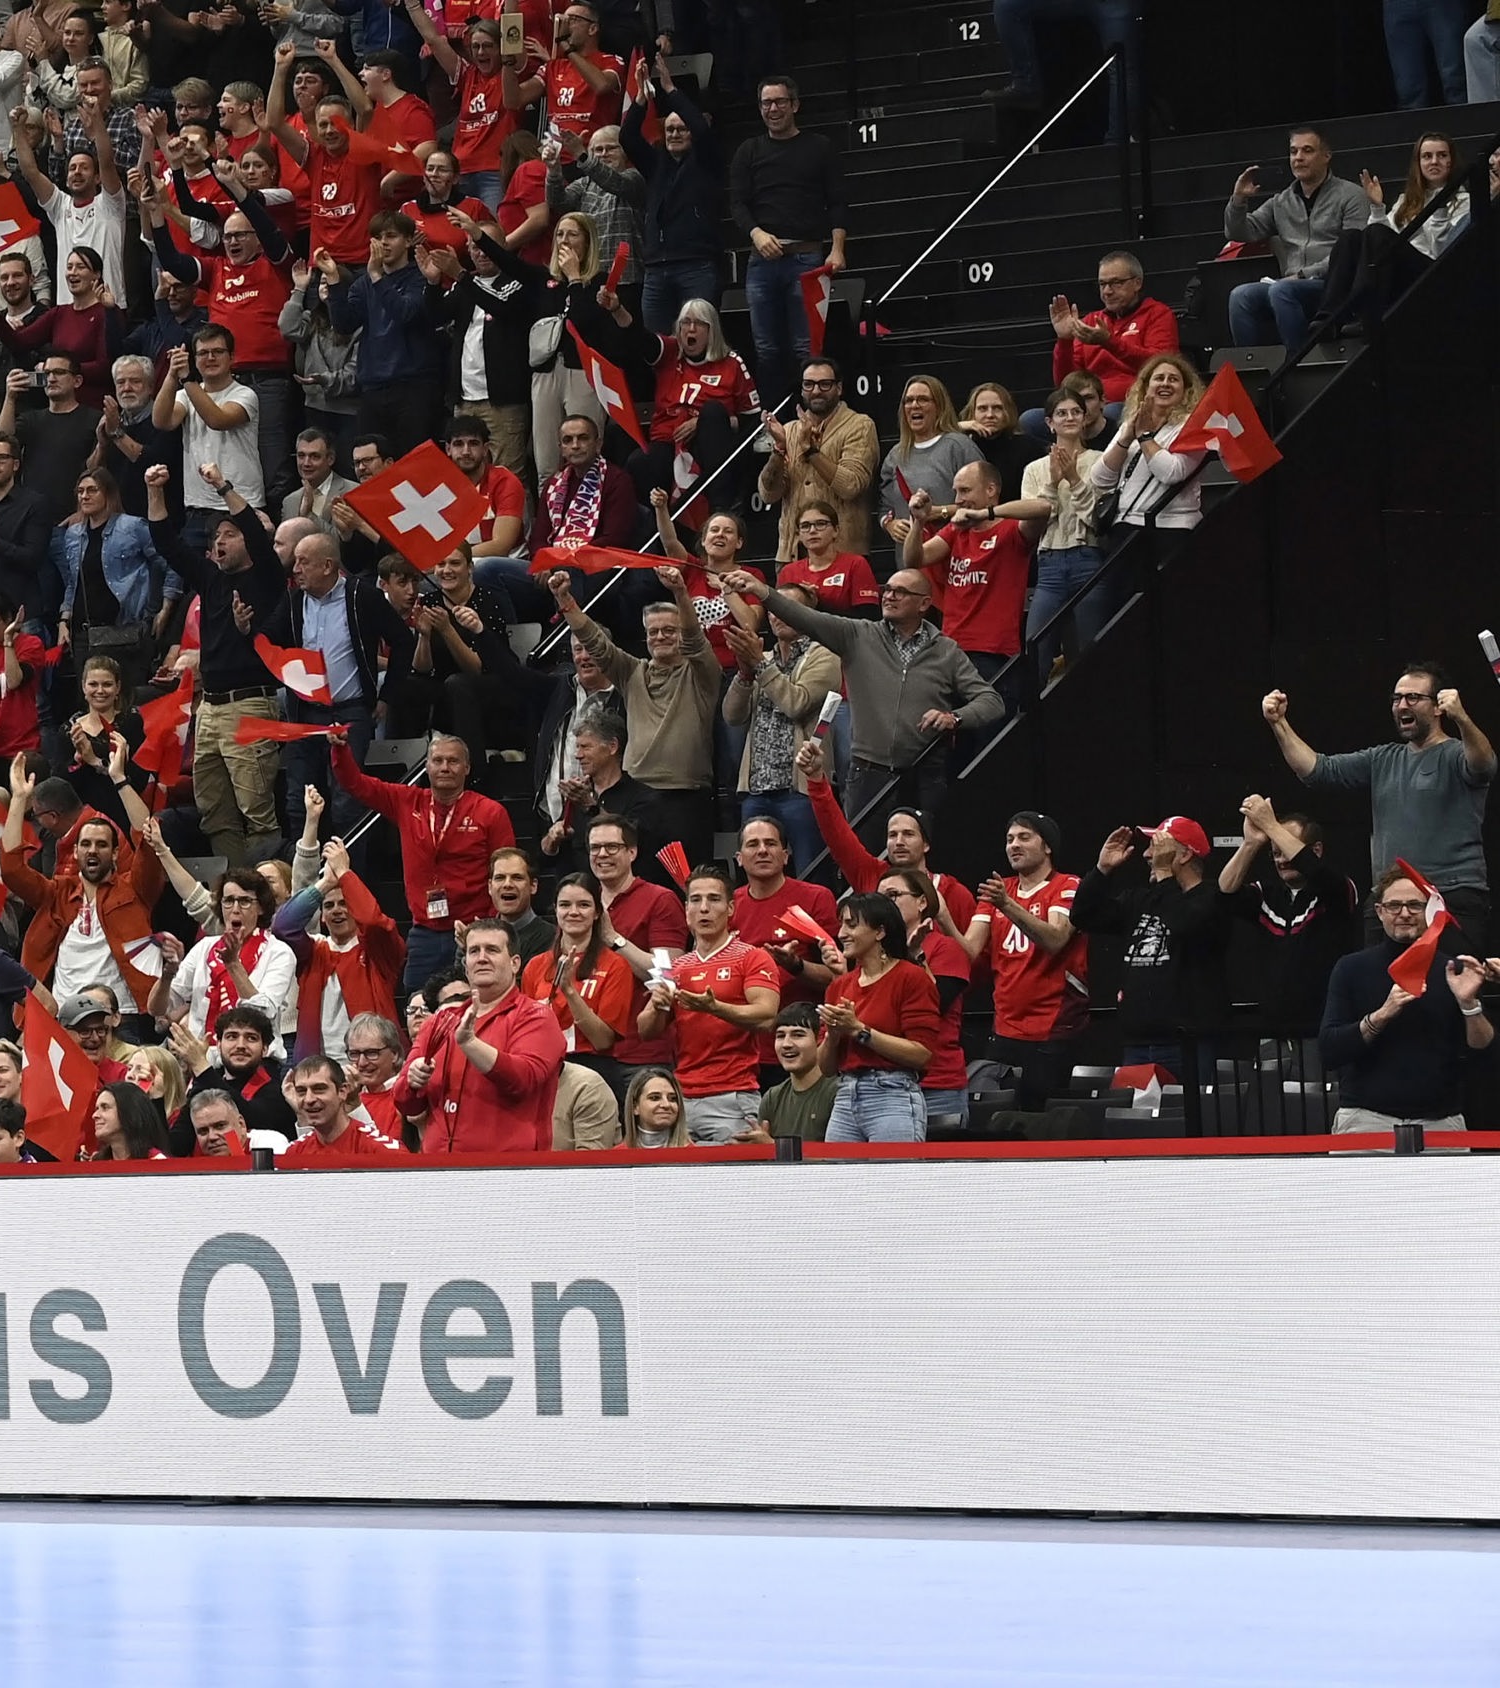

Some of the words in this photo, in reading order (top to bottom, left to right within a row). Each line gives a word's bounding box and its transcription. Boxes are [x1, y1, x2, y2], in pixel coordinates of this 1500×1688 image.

[959, 21, 980, 41] 12
[859, 124, 877, 143] 11
[969, 262, 993, 284] 09
[680, 383, 701, 405] 17
[178, 1233, 629, 1420] Oven
